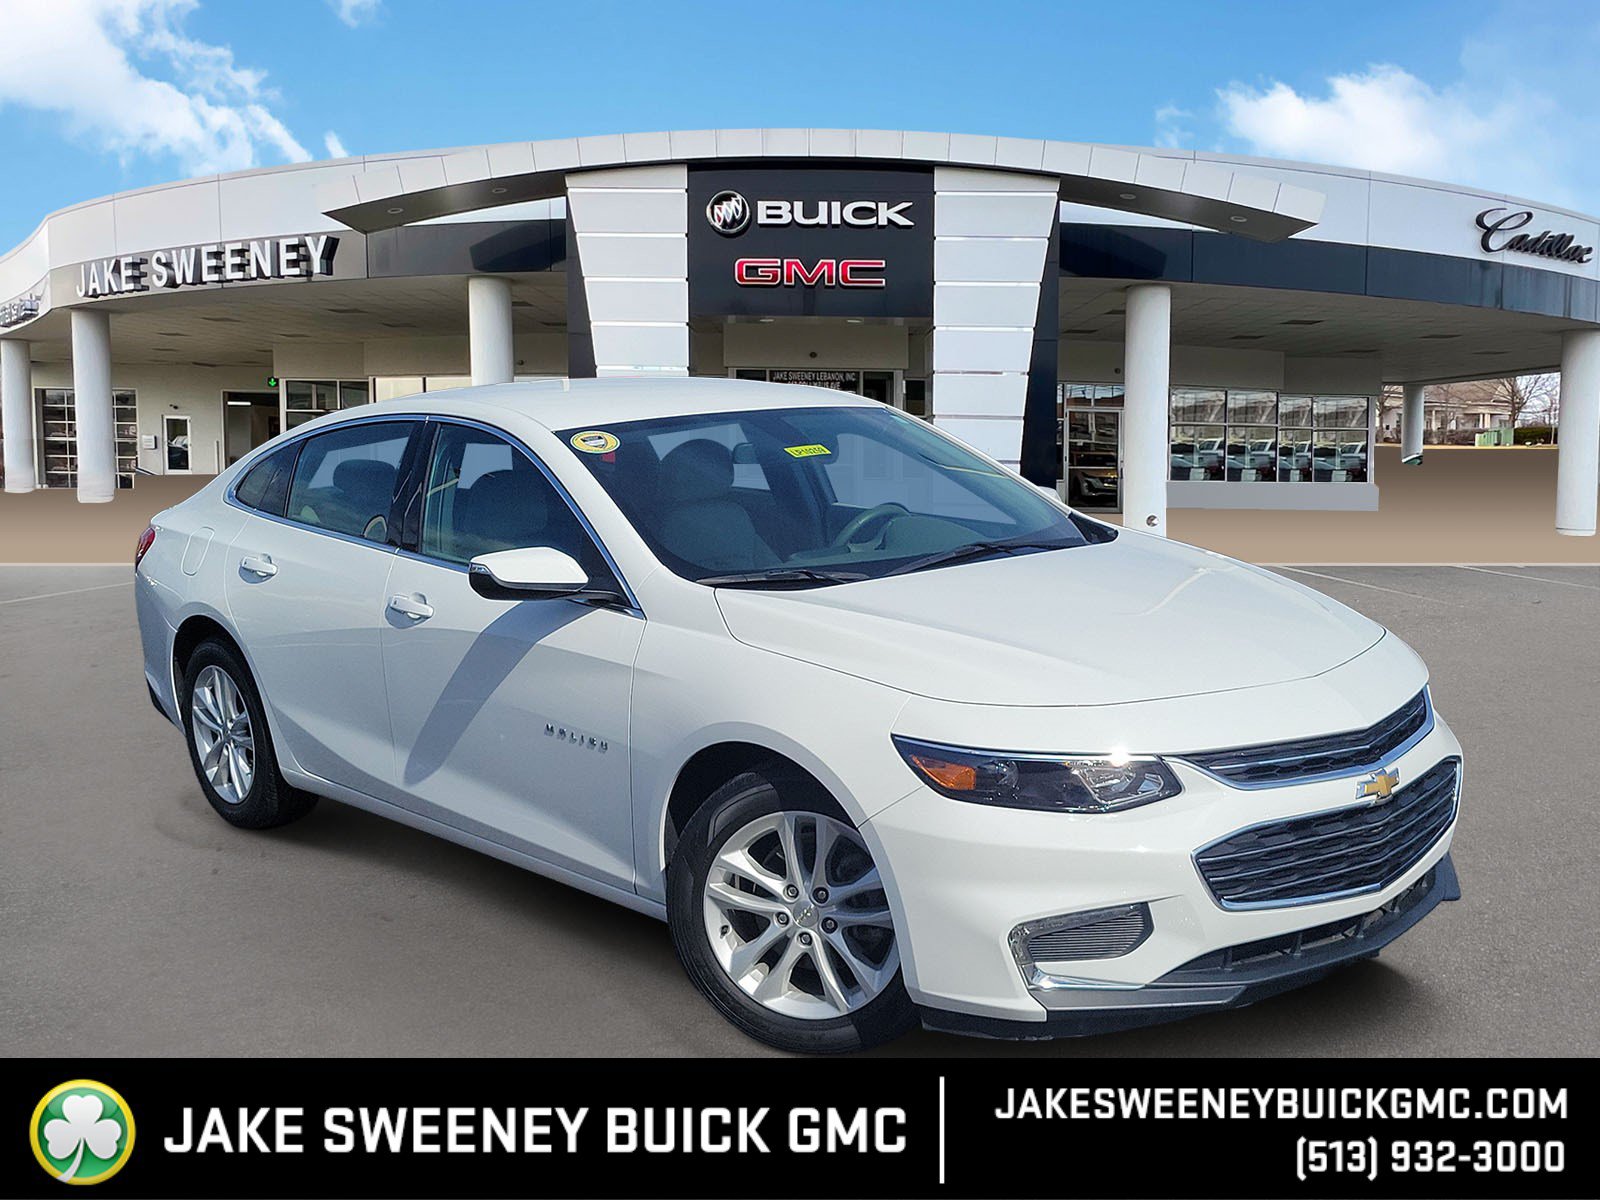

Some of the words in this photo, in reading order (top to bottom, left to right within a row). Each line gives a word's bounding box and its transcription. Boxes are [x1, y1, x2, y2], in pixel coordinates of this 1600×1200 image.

[757, 200, 915, 227] BUICK
[1475, 207, 1593, 264] Cadillac
[76, 256, 142, 298] JAKE
[151, 235, 333, 288] SWEENEY
[734, 258, 886, 287] GMC
[773, 371, 788, 381] JAKE
[788, 371, 815, 381] SWEENEY
[544, 723, 609, 753] MALIBU
